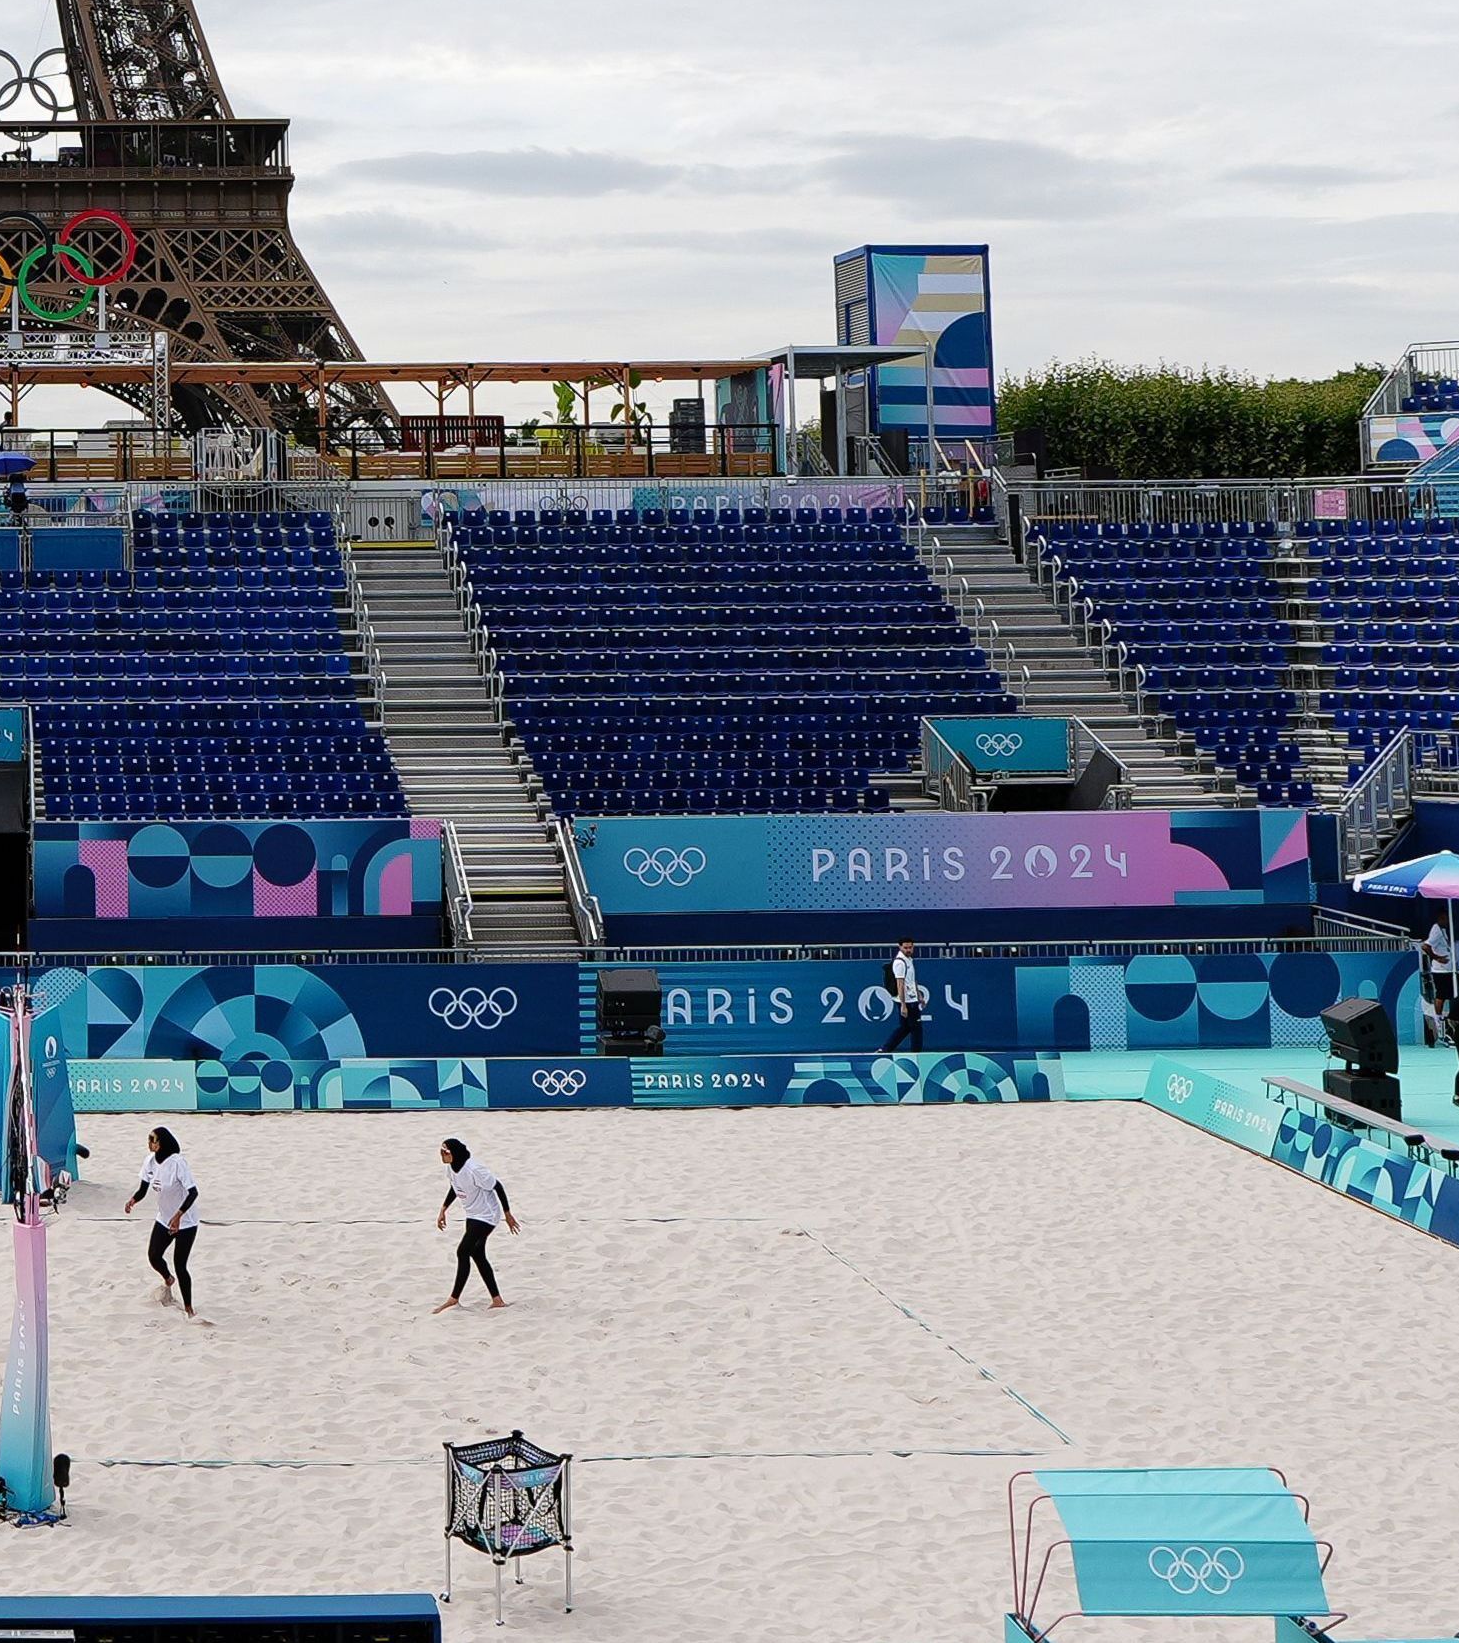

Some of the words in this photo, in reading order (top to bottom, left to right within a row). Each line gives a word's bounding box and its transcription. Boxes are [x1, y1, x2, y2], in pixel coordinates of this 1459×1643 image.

[989, 843, 1128, 880] 2024
[667, 986, 794, 1025] ARIS
[130, 1078, 184, 1093] 2024
[711, 1072, 766, 1088] 2024
[1244, 1112, 1273, 1136] 2024
